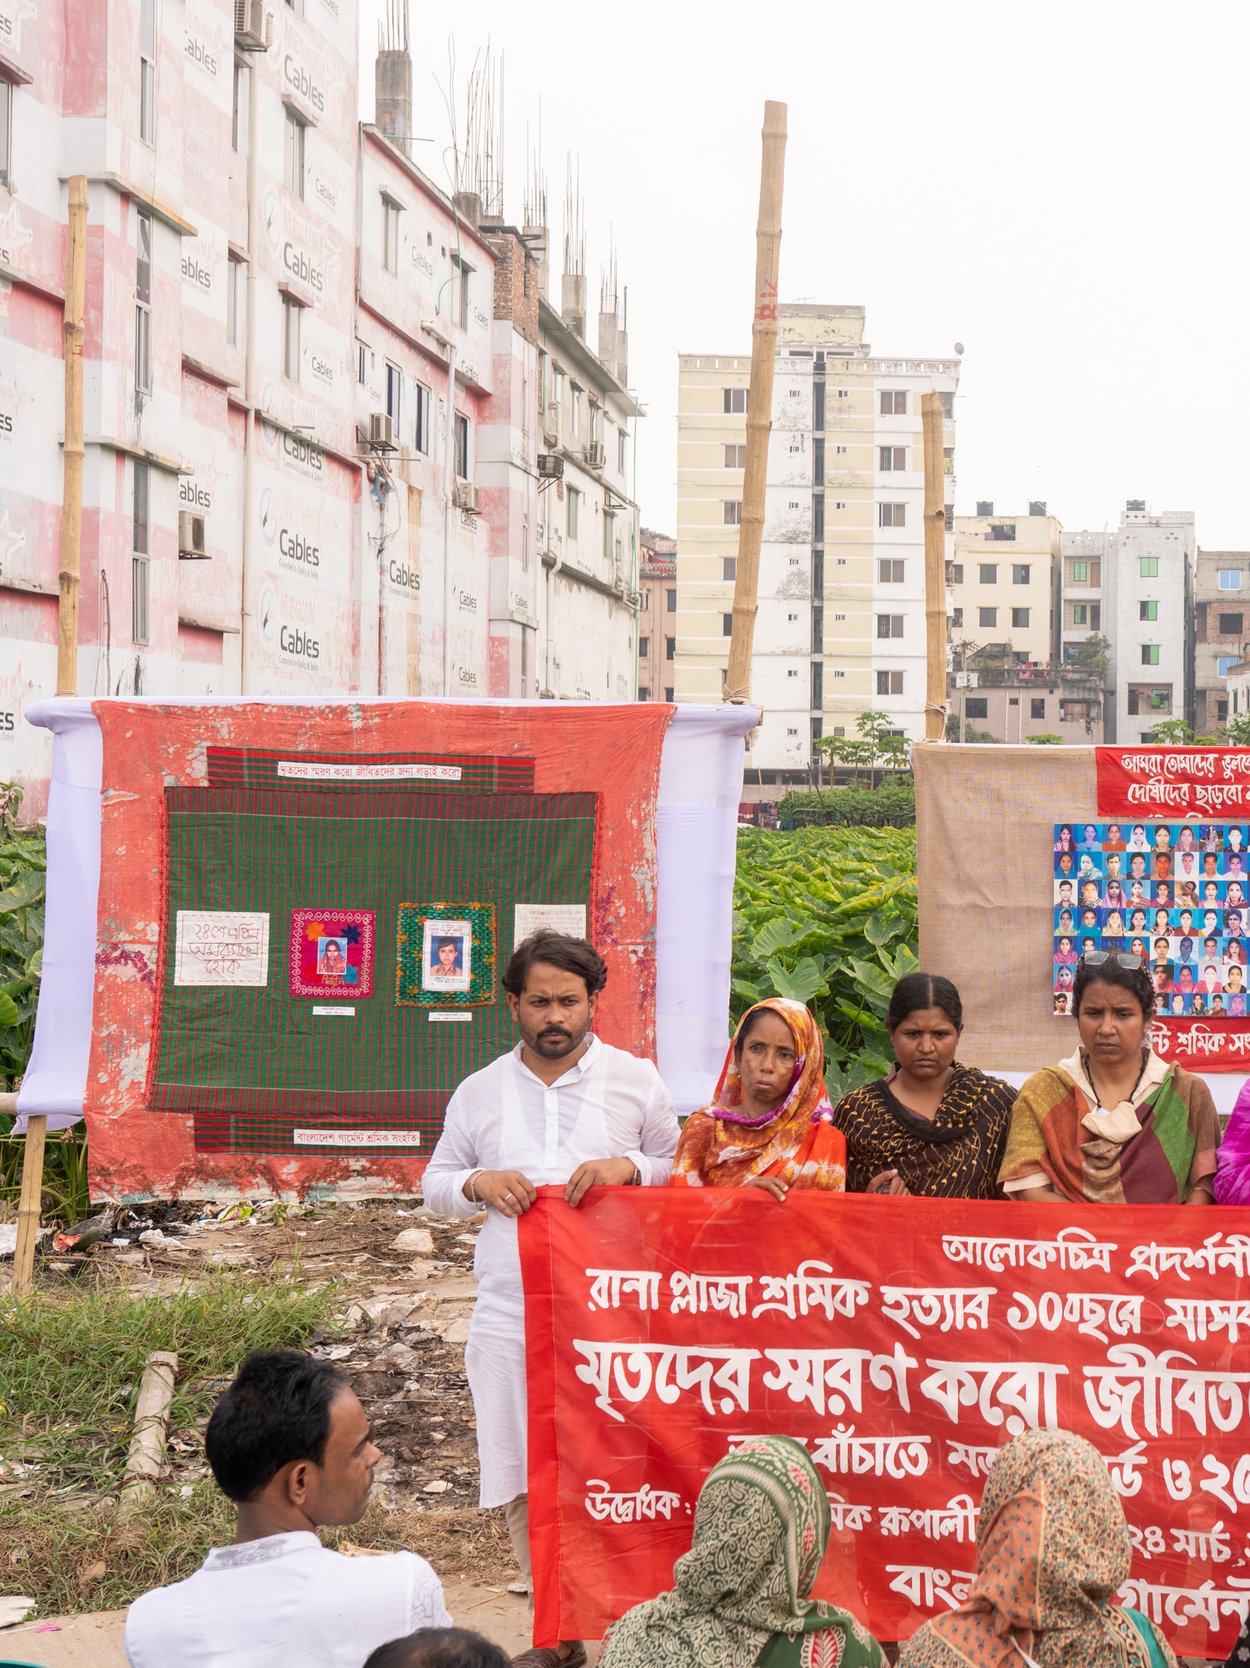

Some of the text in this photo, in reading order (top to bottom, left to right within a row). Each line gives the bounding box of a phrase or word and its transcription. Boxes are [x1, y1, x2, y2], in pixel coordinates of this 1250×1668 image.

[185, 30, 217, 76] ables
[284, 54, 325, 112] Cables
[181, 257, 211, 288] ables
[284, 242, 323, 291] Cables
[312, 356, 333, 380] Cables
[179, 481, 211, 508] ables
[279, 529, 320, 566] Cables
[389, 560, 420, 590] Cables
[459, 590, 478, 609] Cables
[280, 625, 320, 658] Cables
[459, 666, 476, 684] Cables
[280, 764, 460, 779] মৃতদের স্মরণ করো জীবিতদের জন্য লড়াই করো
[1121, 754, 1163, 777] আমরা
[1163, 753, 1219, 778] তোমাদের
[1127, 777, 1190, 806] দোষীদের
[1193, 784, 1243, 814] ছাড়বো
[1176, 1023, 1227, 1055] শ্রমিক
[297, 1132, 335, 1143] বাংলাদেশ
[391, 1131, 417, 1143] সংহতি
[942, 1227, 1119, 1274] আলোকচিত্র
[585, 1268, 663, 1311] রানা
[669, 1271, 753, 1319] প্লাজা
[752, 1260, 872, 1320] শ্রমিক
[880, 1286, 998, 1339] হত্যার
[573, 1339, 763, 1422] মৃতদের
[763, 1341, 919, 1416] স্মরণ
[920, 1358, 1069, 1437] করো
[811, 1422, 932, 1479] বাঁচাতে
[1162, 1457, 1192, 1500] ও
